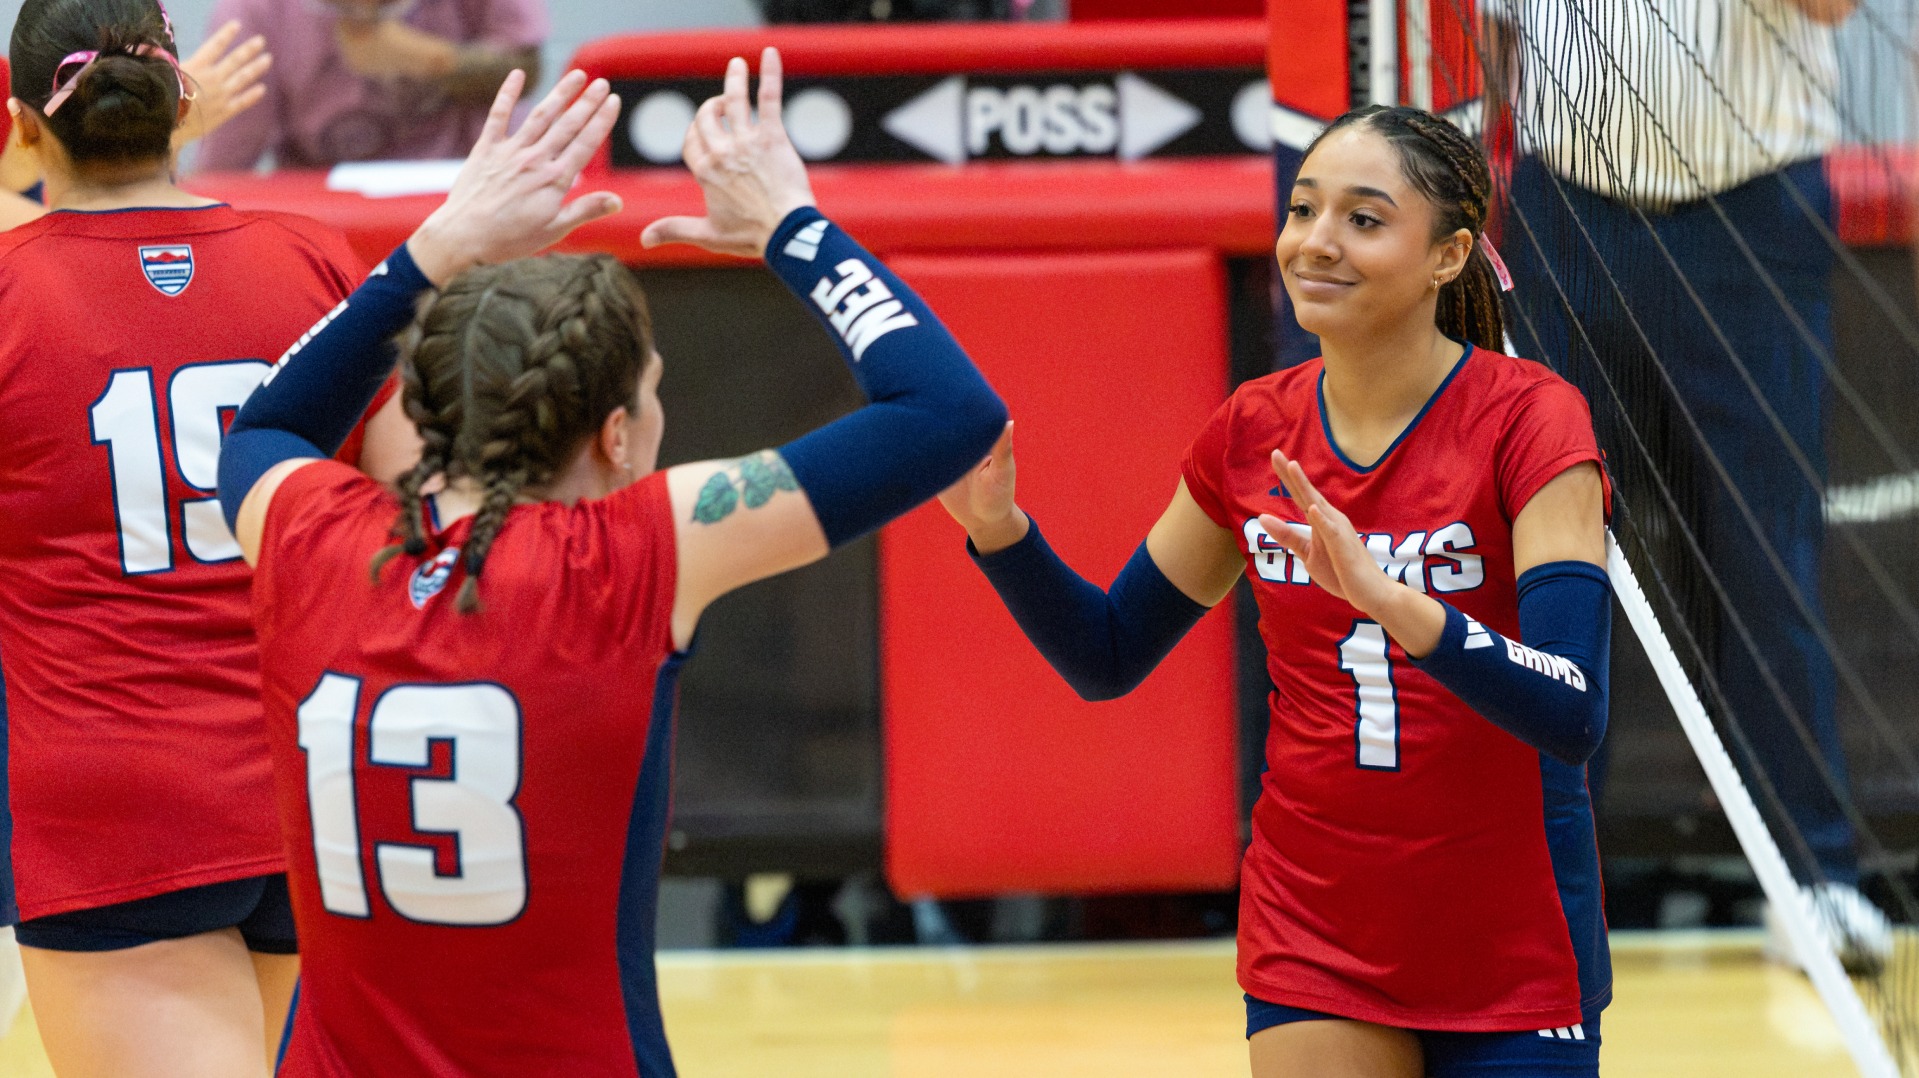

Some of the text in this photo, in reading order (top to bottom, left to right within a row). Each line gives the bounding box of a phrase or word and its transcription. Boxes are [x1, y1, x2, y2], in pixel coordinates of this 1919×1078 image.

[967, 83, 1118, 155] POSS
[809, 258, 919, 362] NEC
[87, 358, 274, 577] 19
[1243, 517, 1486, 595] GMS
[1335, 618, 1401, 773] 1
[1500, 634, 1587, 692] GRIMS
[297, 668, 530, 929] 13
